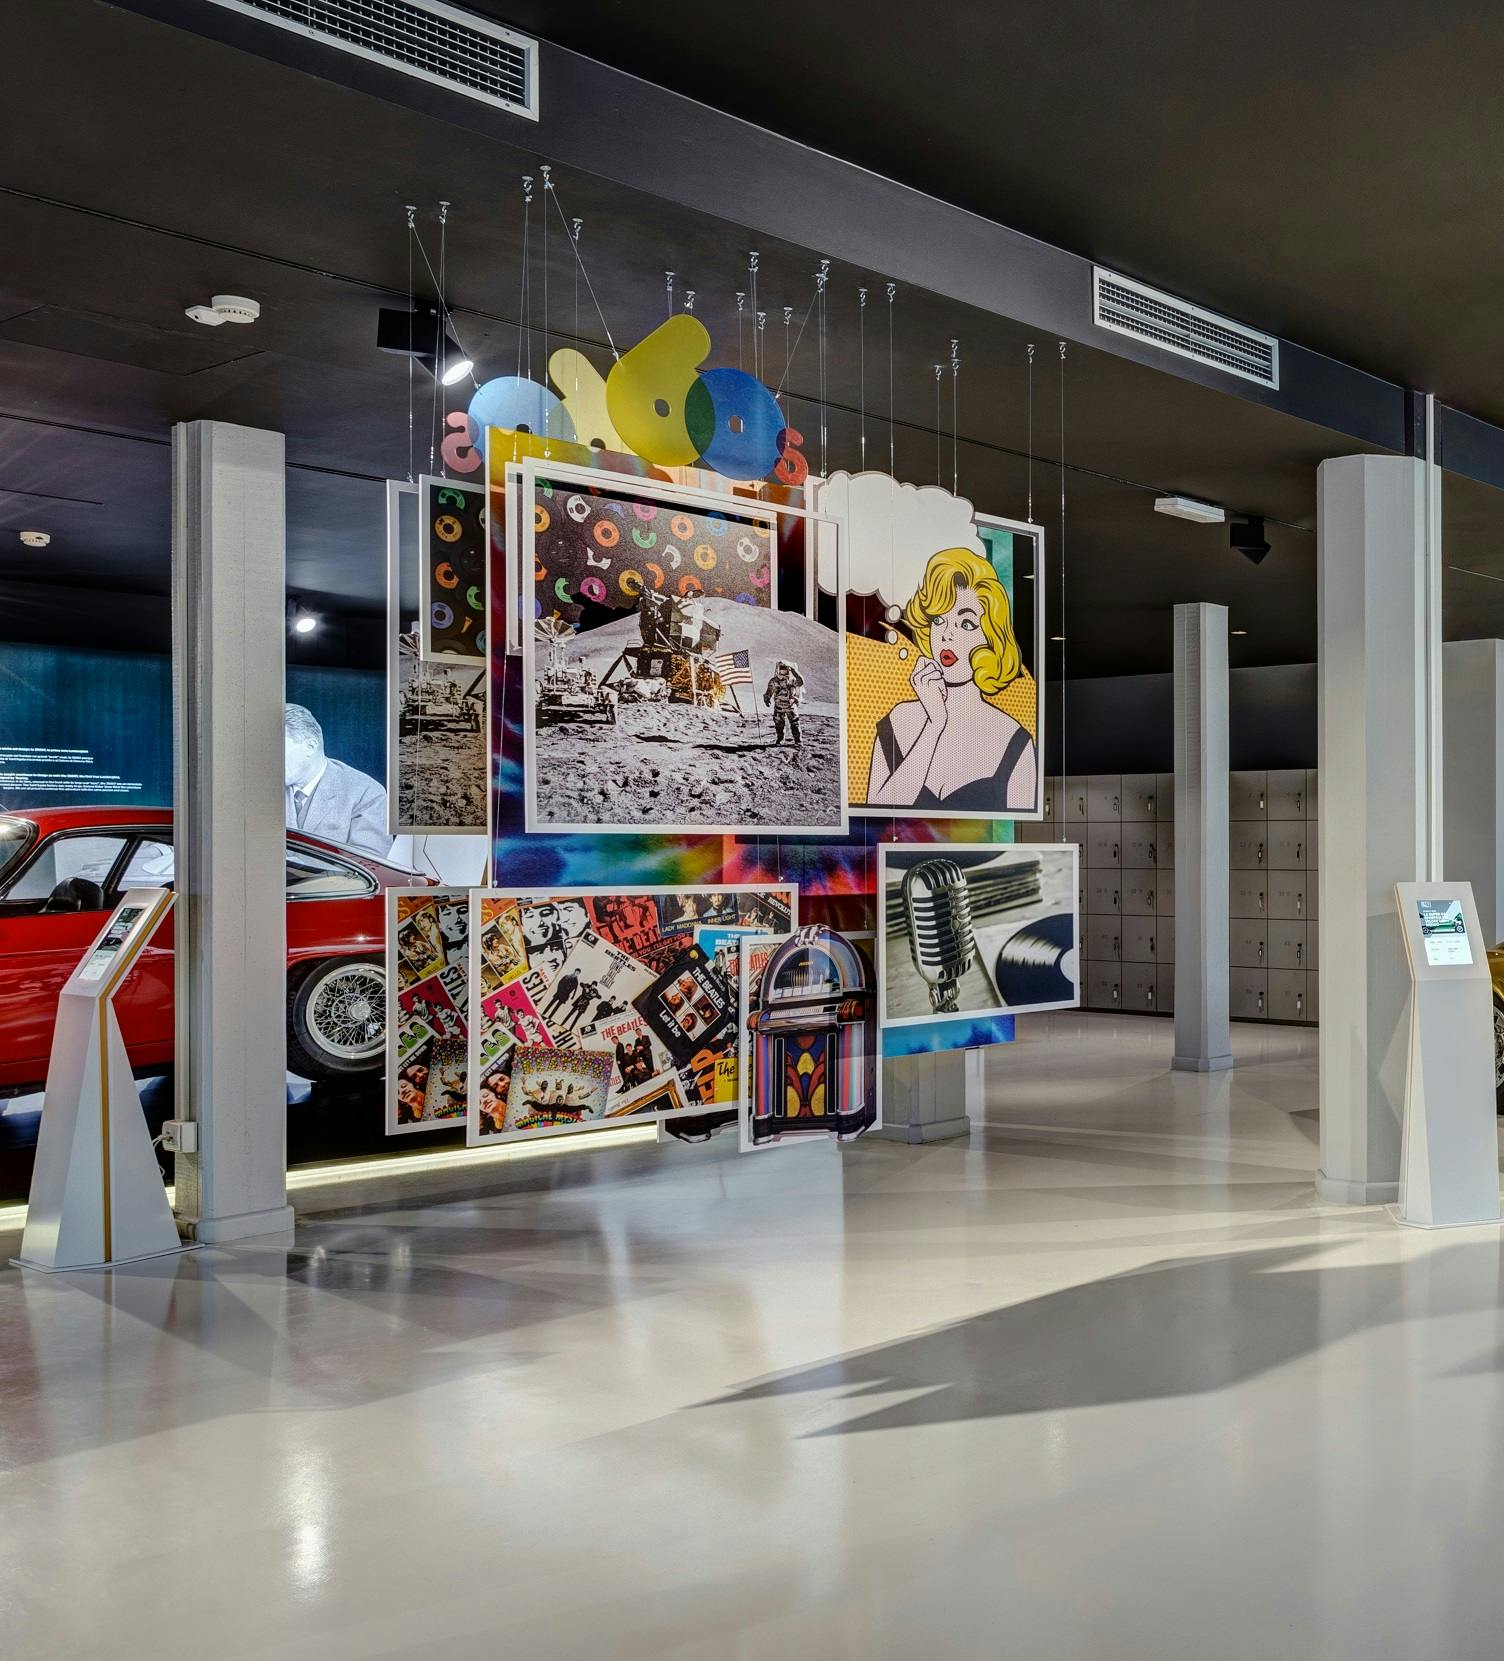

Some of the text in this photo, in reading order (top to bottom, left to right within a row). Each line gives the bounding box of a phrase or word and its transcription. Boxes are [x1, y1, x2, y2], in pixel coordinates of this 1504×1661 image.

[661, 923, 675, 933] LADY
[604, 948, 637, 972] BEATLES
[616, 950, 630, 962] THE
[692, 966, 705, 983] THE
[701, 980, 726, 1009] BEATLES
[658, 1009, 669, 1023] Let
[600, 1025, 617, 1041] THE
[716, 1061, 736, 1077] The
[514, 1111, 553, 1129] MAGICAL
